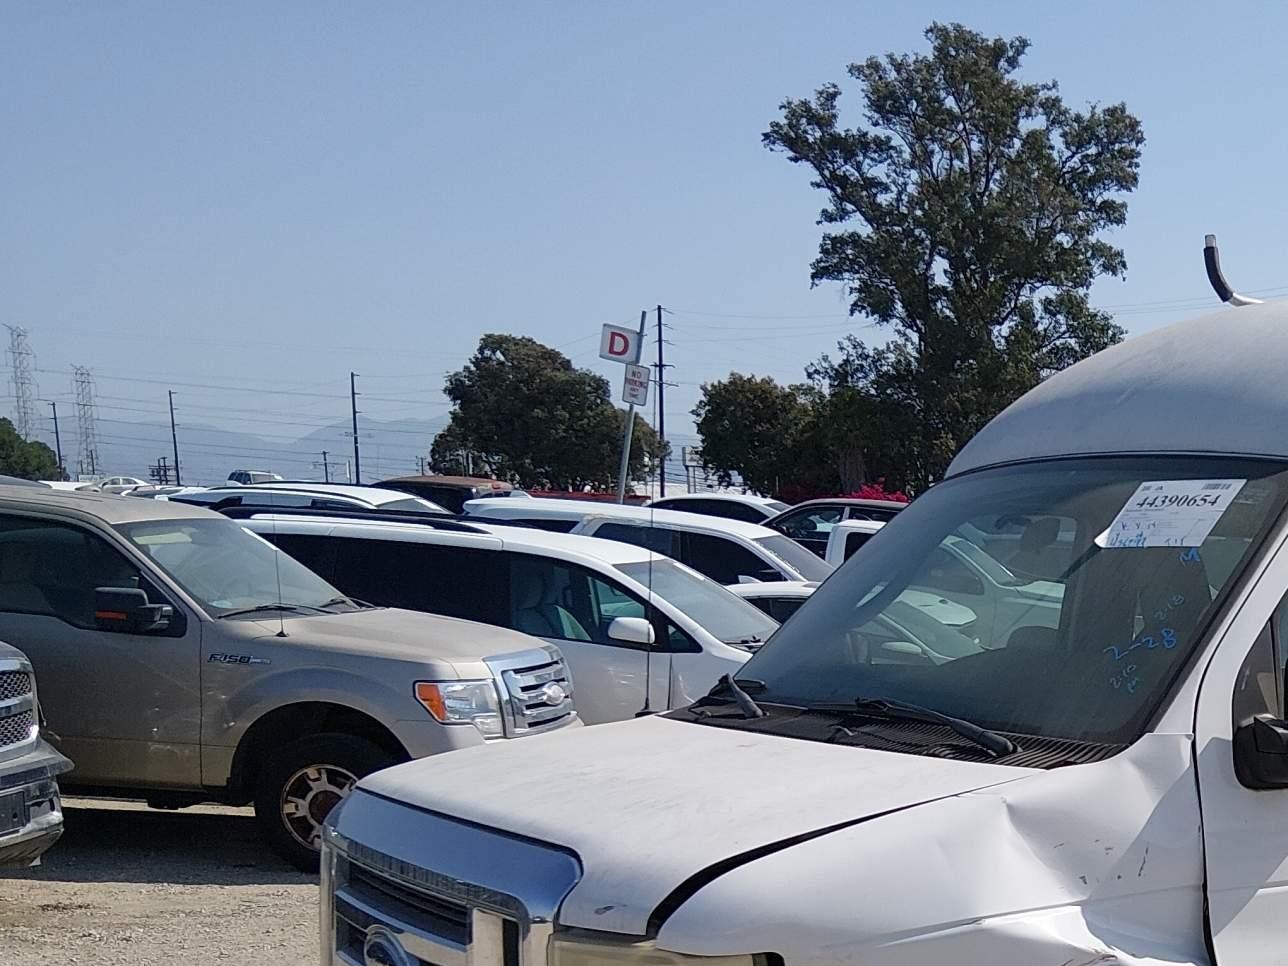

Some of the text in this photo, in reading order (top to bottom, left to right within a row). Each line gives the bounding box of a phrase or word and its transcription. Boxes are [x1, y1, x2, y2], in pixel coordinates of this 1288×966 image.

[608, 332, 629, 356] D
[631, 370, 642, 378] NO
[1136, 494, 1222, 508] 44390654
